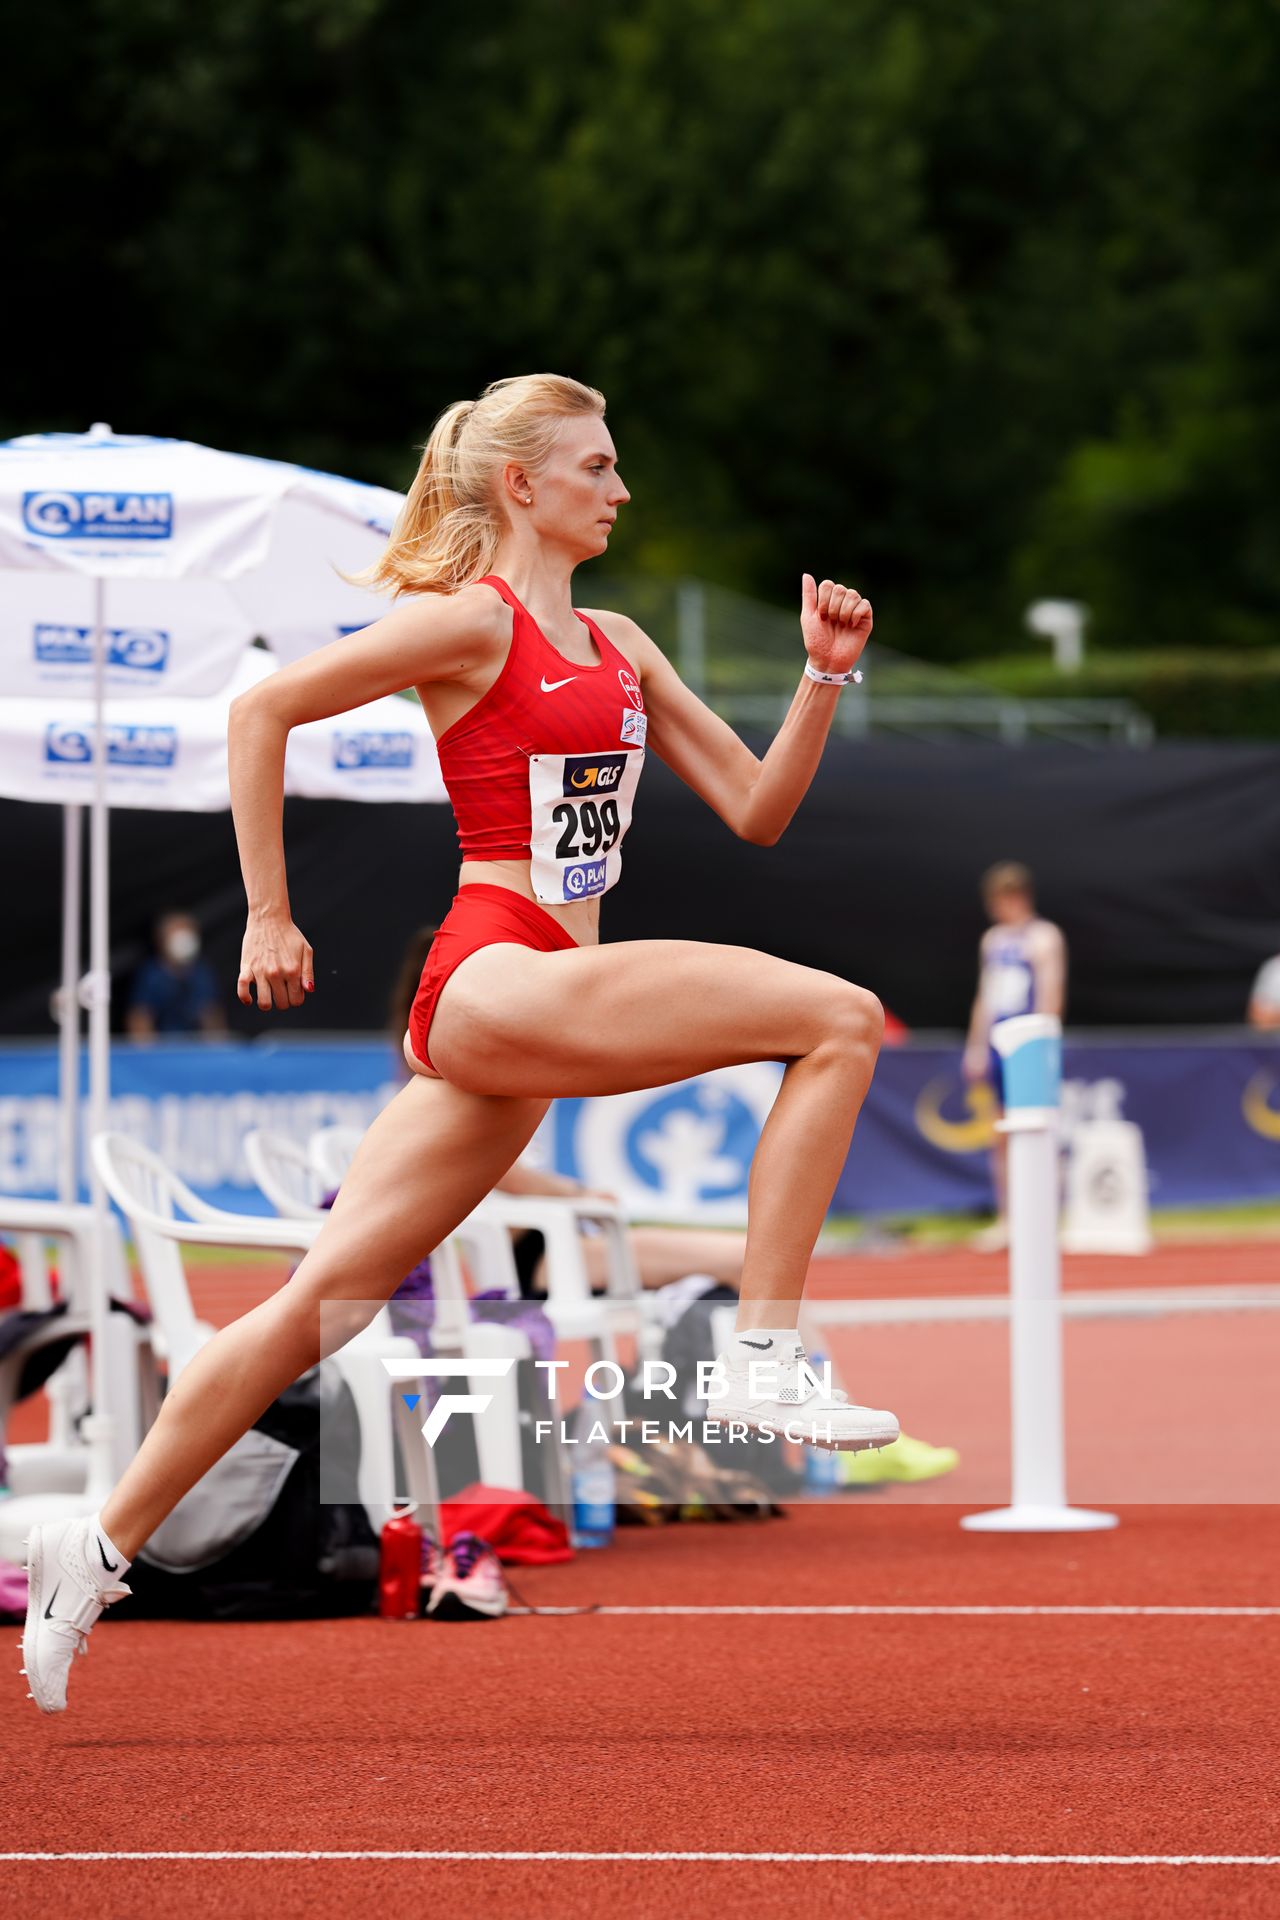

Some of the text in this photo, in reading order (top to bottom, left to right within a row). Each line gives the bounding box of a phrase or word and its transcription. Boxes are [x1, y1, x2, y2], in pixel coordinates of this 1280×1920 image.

[84, 495, 168, 522] PLAN
[597, 766, 620, 787] GLS
[552, 799, 620, 859] 299
